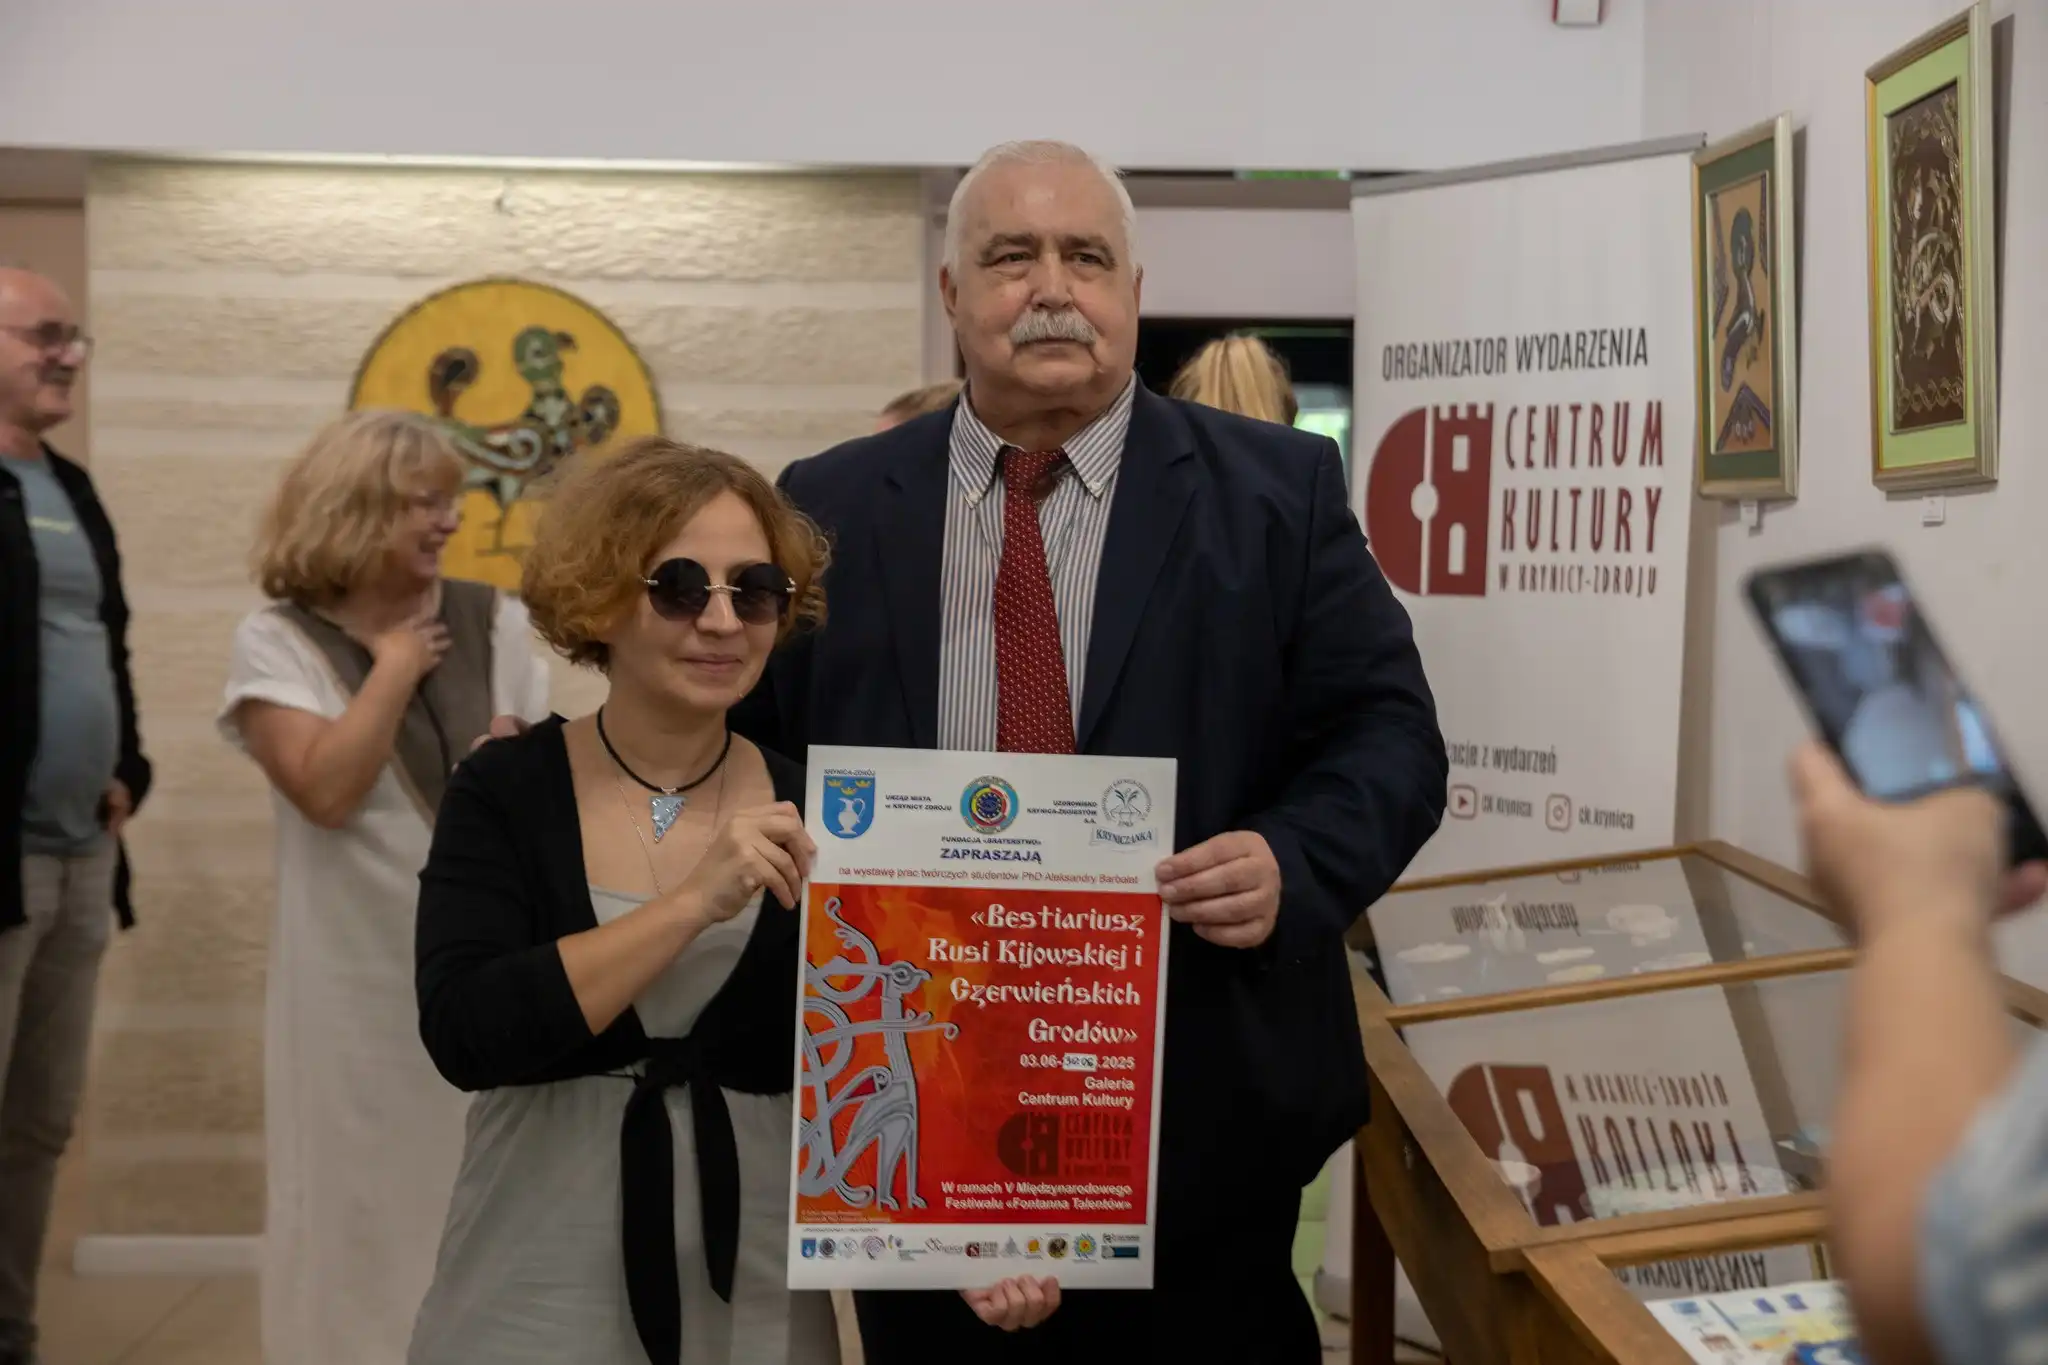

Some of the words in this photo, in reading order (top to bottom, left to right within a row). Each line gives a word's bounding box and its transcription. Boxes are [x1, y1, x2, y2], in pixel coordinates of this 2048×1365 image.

[1382, 336, 1507, 381] ORGANIZATOR
[1515, 327, 1649, 373] WYDARZENIA
[1504, 401, 1664, 470] CENTRUM
[1501, 487, 1664, 553] KULTURY
[1499, 564, 1508, 592] W
[1518, 564, 1658, 597] KRYNICY-ZDROJU
[1482, 745, 1489, 768] z
[1492, 744, 1558, 775] wydarzeń
[941, 836, 981, 844] FUNDACJA
[1096, 828, 1153, 845] KRYNICZANKA
[940, 848, 1042, 864] ZAPRASZAJĄ
[838, 866, 851, 875] na
[853, 867, 895, 879] wystawę
[897, 869, 918, 879] prac
[920, 868, 968, 880] twórczych
[970, 869, 1019, 881] studentów
[1022, 871, 1043, 881] PhD
[1044, 872, 1096, 884] Aleksandry
[927, 937, 990, 964] Rusi
[996, 939, 1128, 973] Kijowskiej
[1135, 944, 1143, 968] i
[949, 976, 1141, 1010] Czerwieńskich
[1028, 1017, 1138, 1045] Grodów»
[1084, 1076, 1135, 1091] Galeria
[1018, 1091, 1080, 1106] Centrum
[1082, 1092, 1134, 1110] Kultury
[941, 1181, 955, 1194] W
[956, 1181, 1003, 1194] ramach
[1004, 1181, 1015, 1194] V
[1016, 1181, 1133, 1197] Międzynarodowego
[945, 1196, 1004, 1209] Festiwalu
